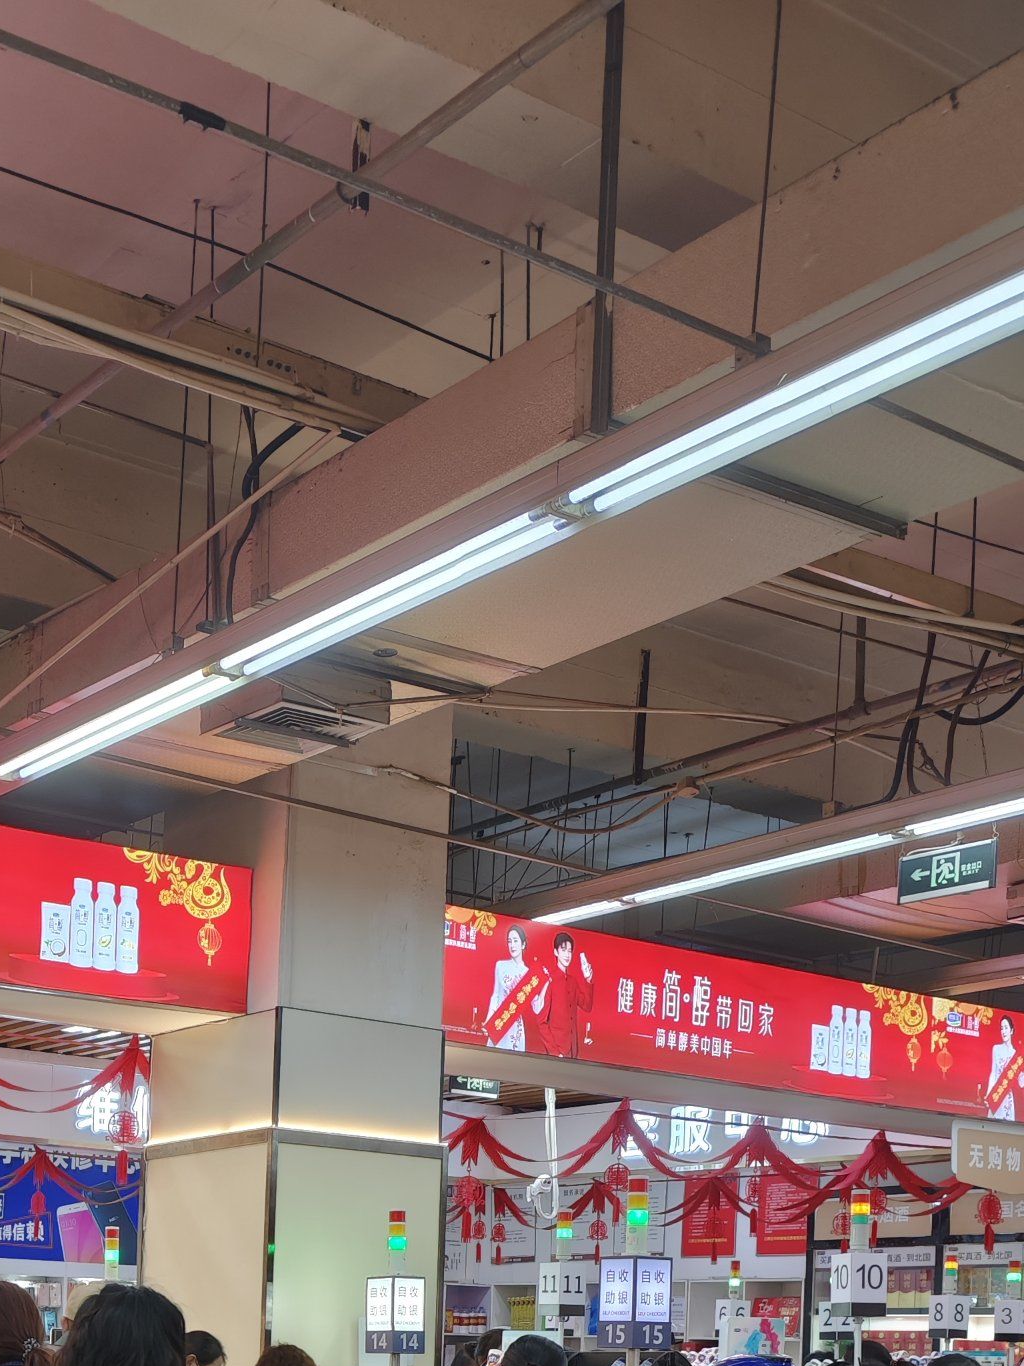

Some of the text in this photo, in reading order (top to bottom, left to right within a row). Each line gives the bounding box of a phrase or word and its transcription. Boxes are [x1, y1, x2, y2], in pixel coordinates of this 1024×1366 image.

[655, 1028, 733, 1059] 简单醇美中国年
[969, 1144, 1021, 1171] 无购物
[542, 1275, 557, 1293] 11
[563, 1275, 583, 1293] 11
[833, 1265, 849, 1289] 10
[856, 1264, 883, 1290] 10
[823, 1309, 833, 1326] 2
[934, 1303, 943, 1322] 8
[954, 1303, 964, 1323] 8
[1001, 1308, 1013, 1325] 3
[371, 1333, 387, 1350] 14
[400, 1333, 419, 1350] 14
[605, 1324, 625, 1344] 15
[642, 1324, 663, 1345] 15
